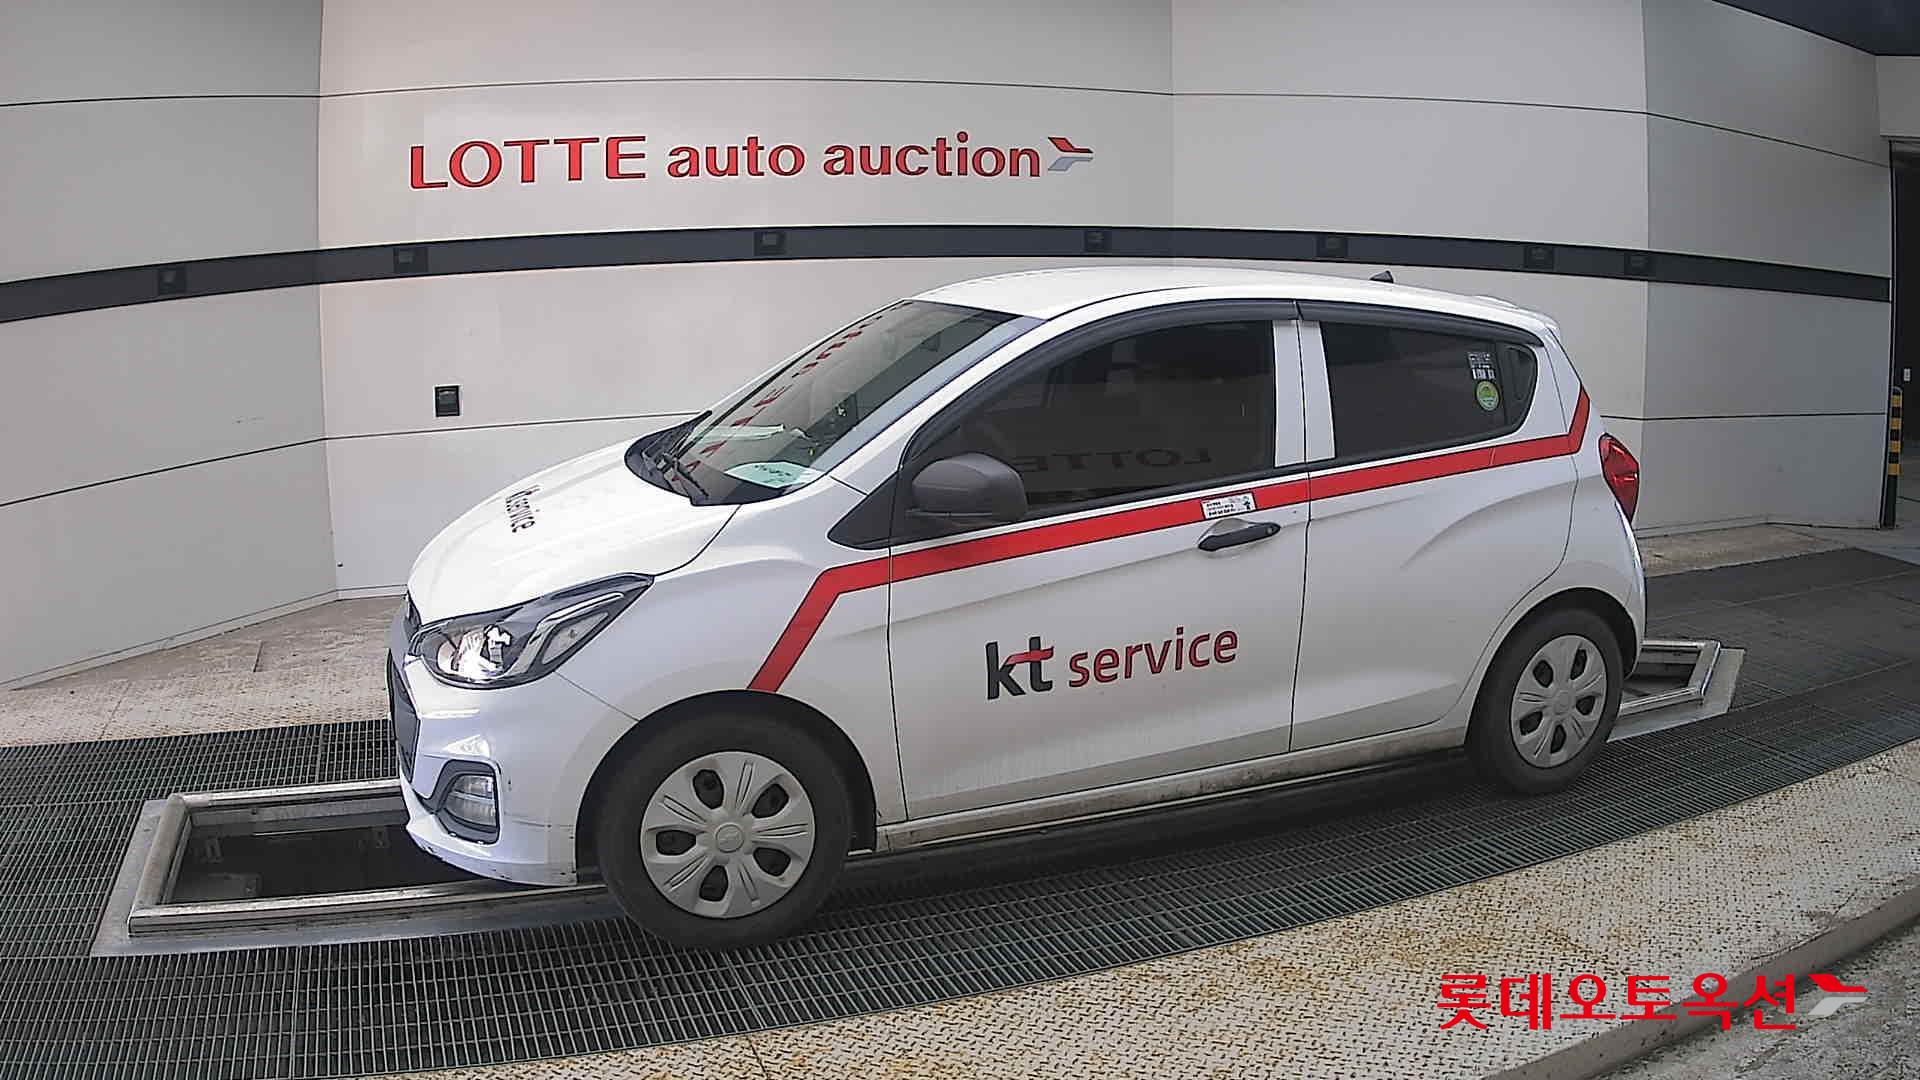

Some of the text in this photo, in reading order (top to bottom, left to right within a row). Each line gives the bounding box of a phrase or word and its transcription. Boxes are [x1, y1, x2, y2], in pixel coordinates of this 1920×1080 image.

[411, 131, 1040, 189] LOTTE auto auction
[506, 498, 541, 534] service
[985, 626, 1238, 701] kt service
